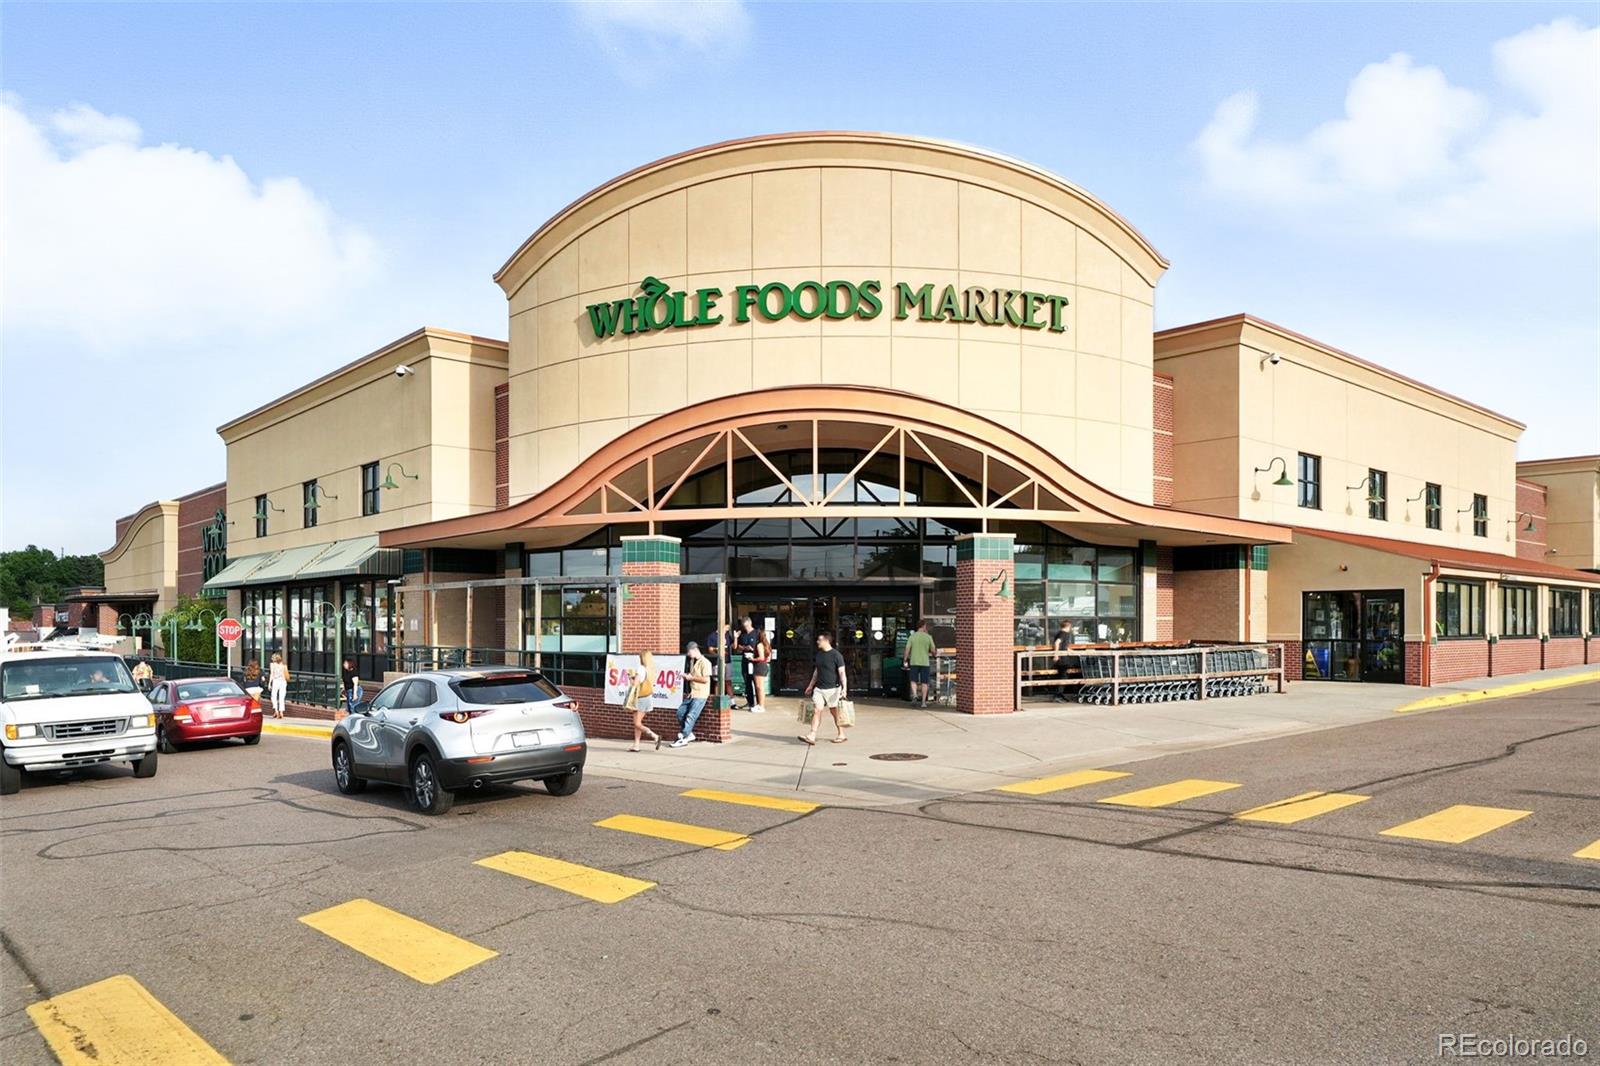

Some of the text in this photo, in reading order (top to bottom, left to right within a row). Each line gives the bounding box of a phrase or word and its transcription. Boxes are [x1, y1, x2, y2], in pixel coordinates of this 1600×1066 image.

[586, 276, 1069, 338] WHOLE FOODS MARKET
[219, 625, 240, 635] STOP
